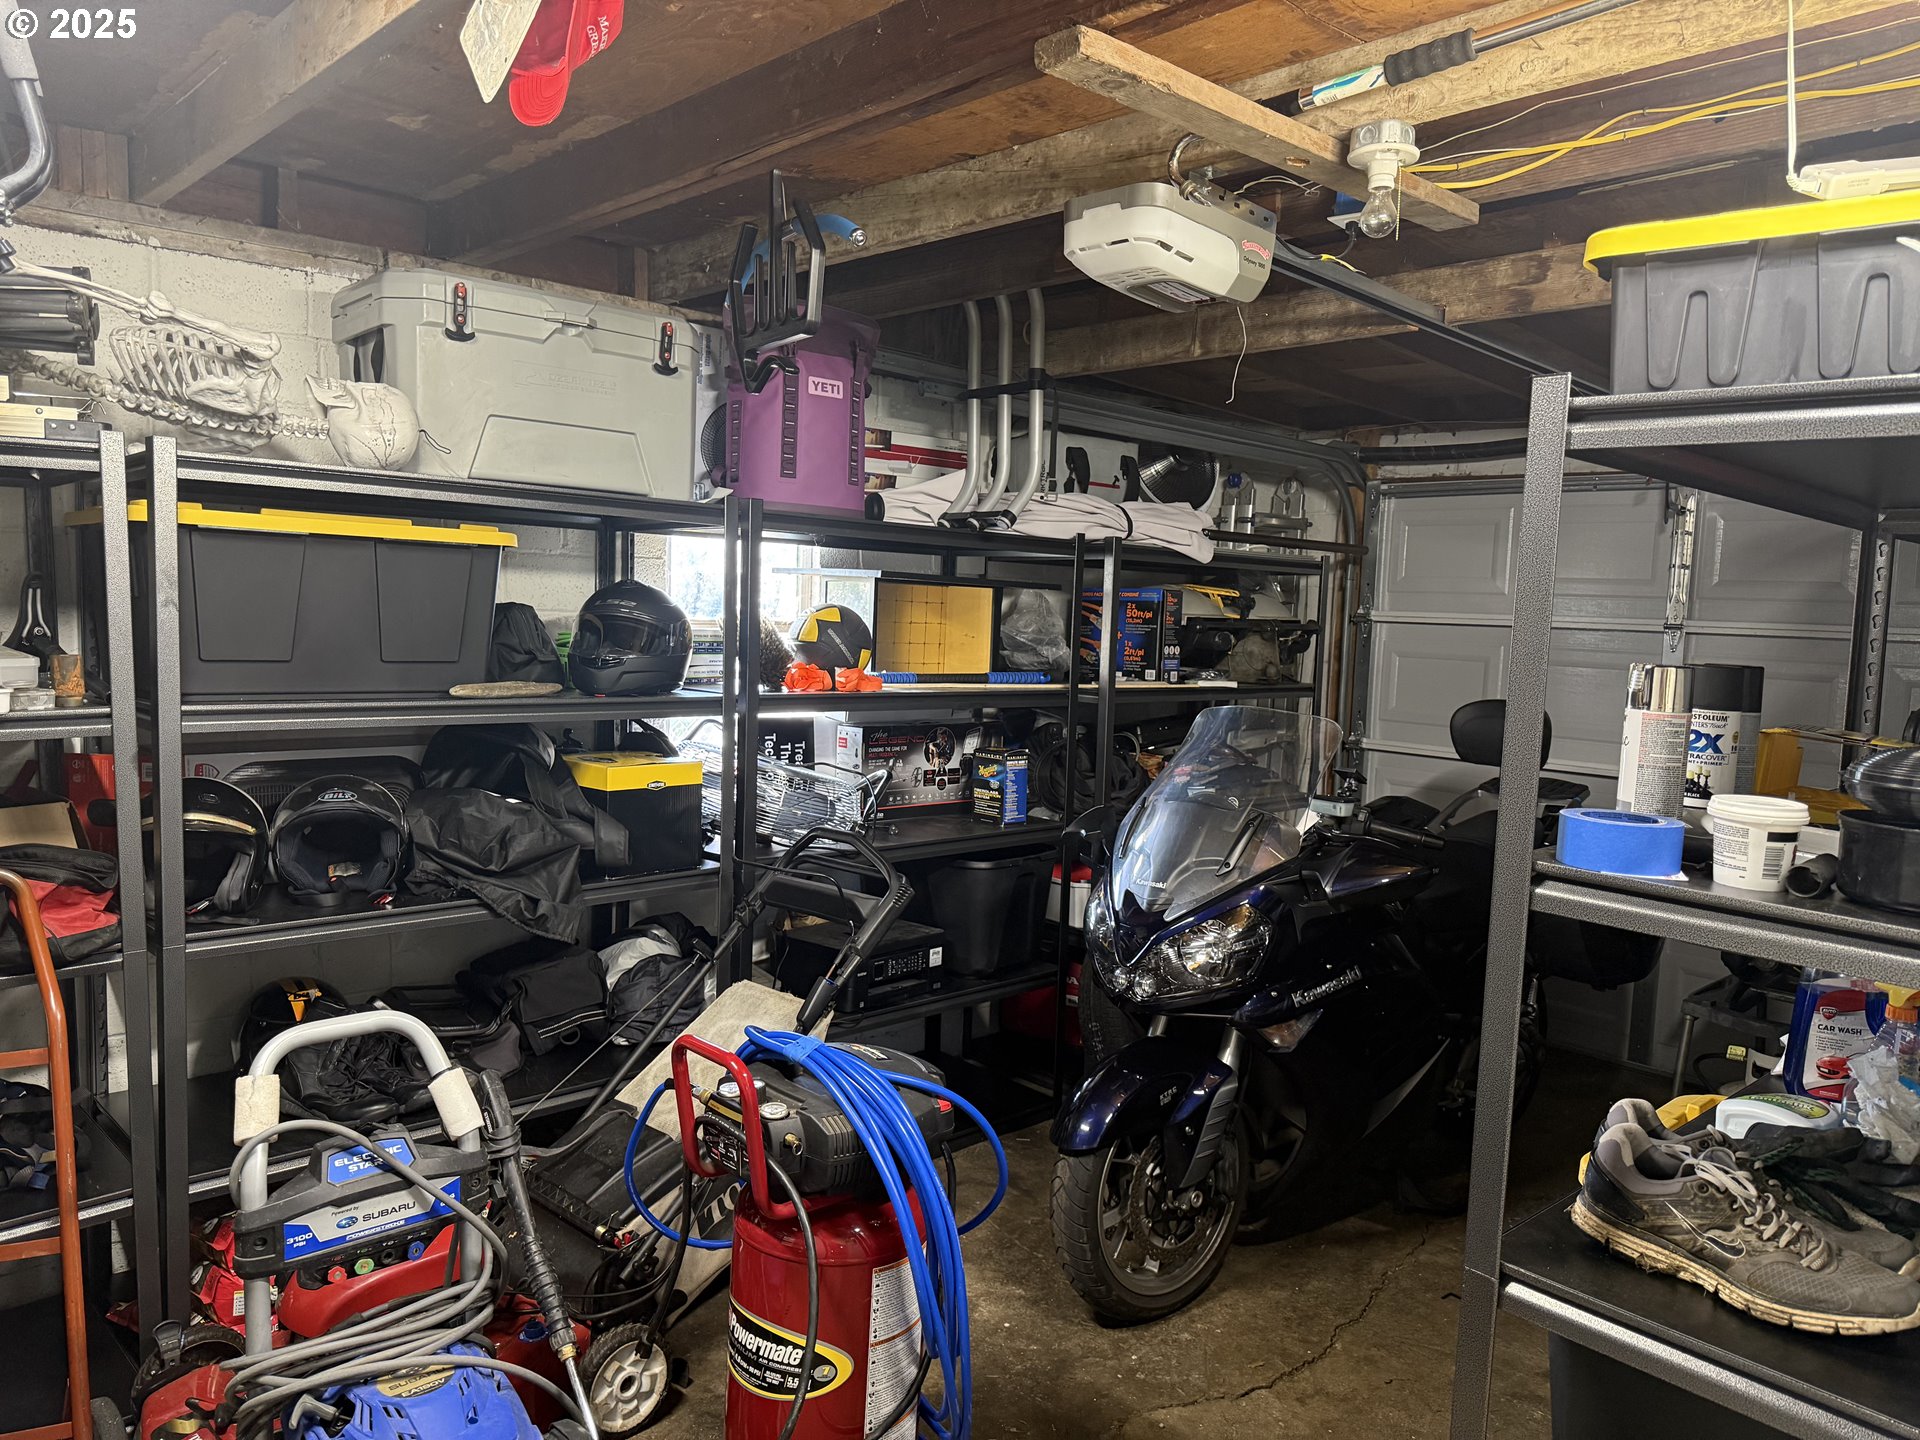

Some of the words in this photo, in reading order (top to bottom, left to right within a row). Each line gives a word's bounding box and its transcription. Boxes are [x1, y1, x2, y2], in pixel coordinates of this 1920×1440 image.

[812, 380, 840, 395] YETI
[1693, 714, 1728, 722] ST-OLEUM
[1688, 729, 1725, 754] 2X
[1689, 753, 1727, 761] RACOVER
[1135, 878, 1167, 889] Kawasaki
[1291, 965, 1363, 1008] Kawasaki
[1817, 1023, 1836, 1032] CAR
[1838, 1026, 1862, 1036] WASH
[334, 1145, 403, 1167] ELECIC
[348, 1158, 384, 1173] STAR
[331, 1208, 350, 1217] Powered
[362, 1201, 416, 1222] SUBARU
[286, 1233, 313, 1245] 3100
[730, 1312, 803, 1365] Powermate
